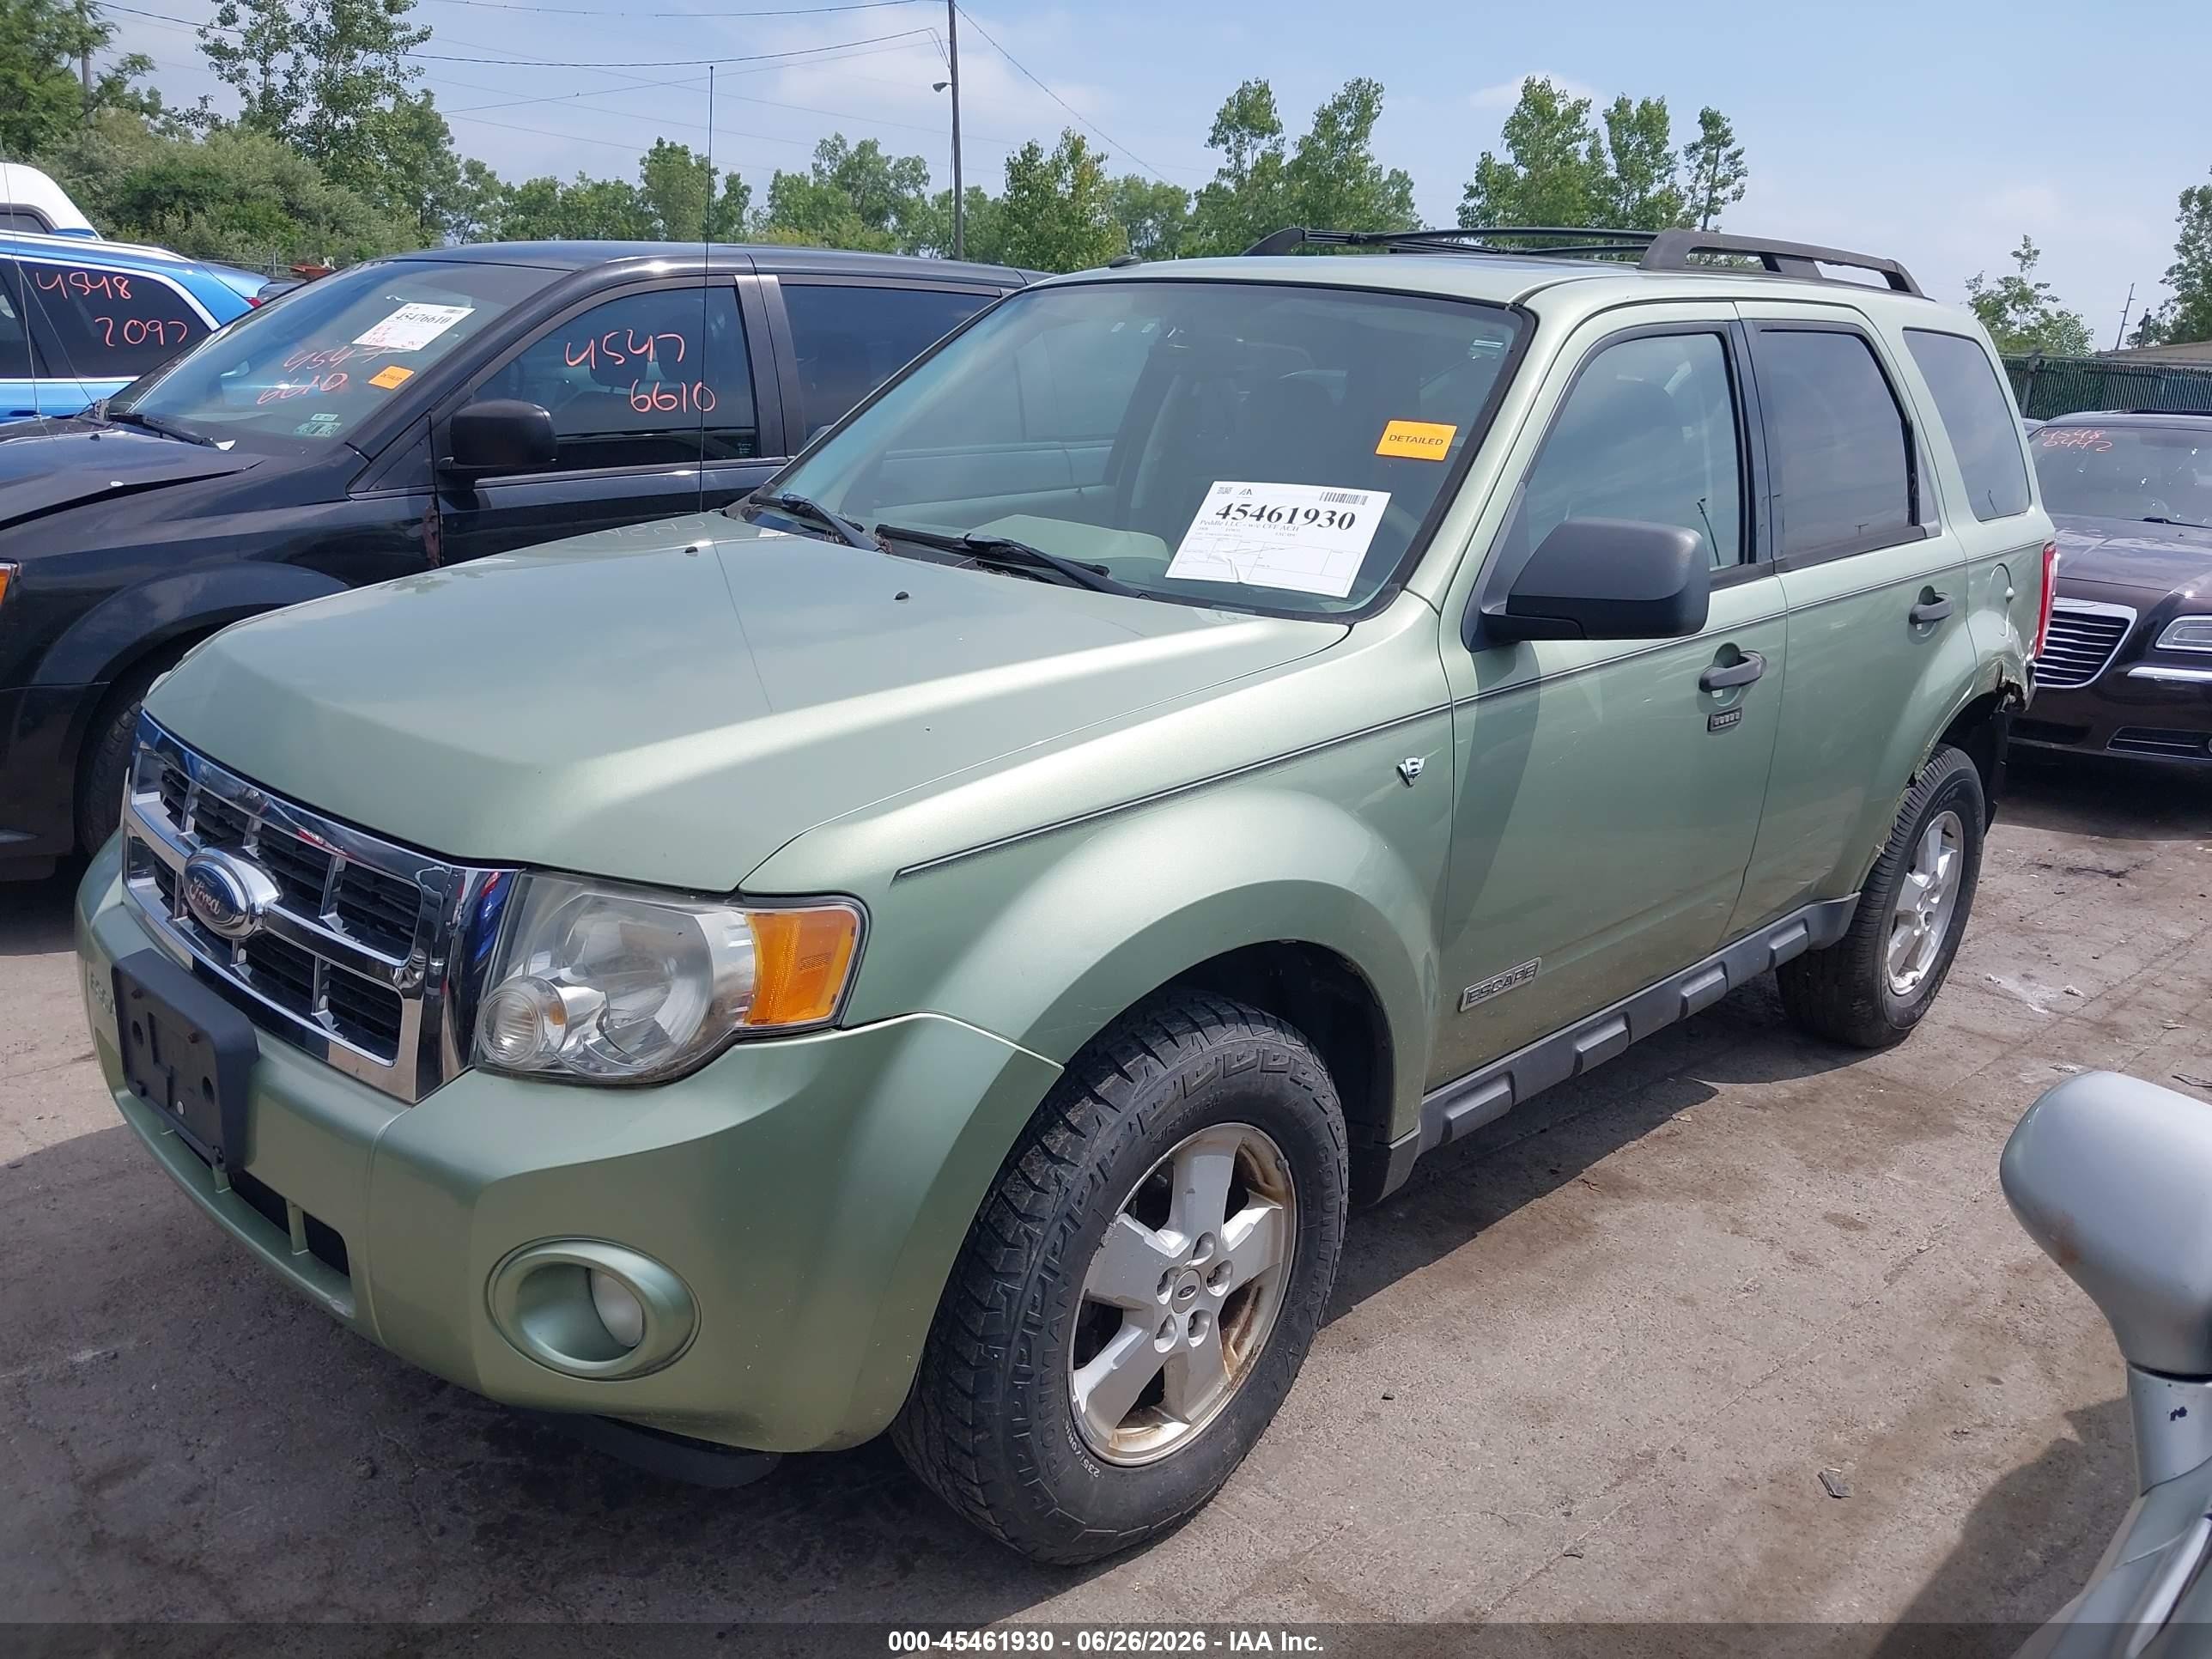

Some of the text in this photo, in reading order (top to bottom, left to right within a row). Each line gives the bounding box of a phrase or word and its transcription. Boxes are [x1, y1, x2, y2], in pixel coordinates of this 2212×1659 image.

[565, 329, 685, 369] 4547
[630, 379, 716, 413] 6610
[1388, 434, 1443, 446] DETAILED
[1215, 502, 1356, 531] 45461930
[189, 875, 221, 915] Ford
[1466, 963, 1538, 1005] ESCAPE
